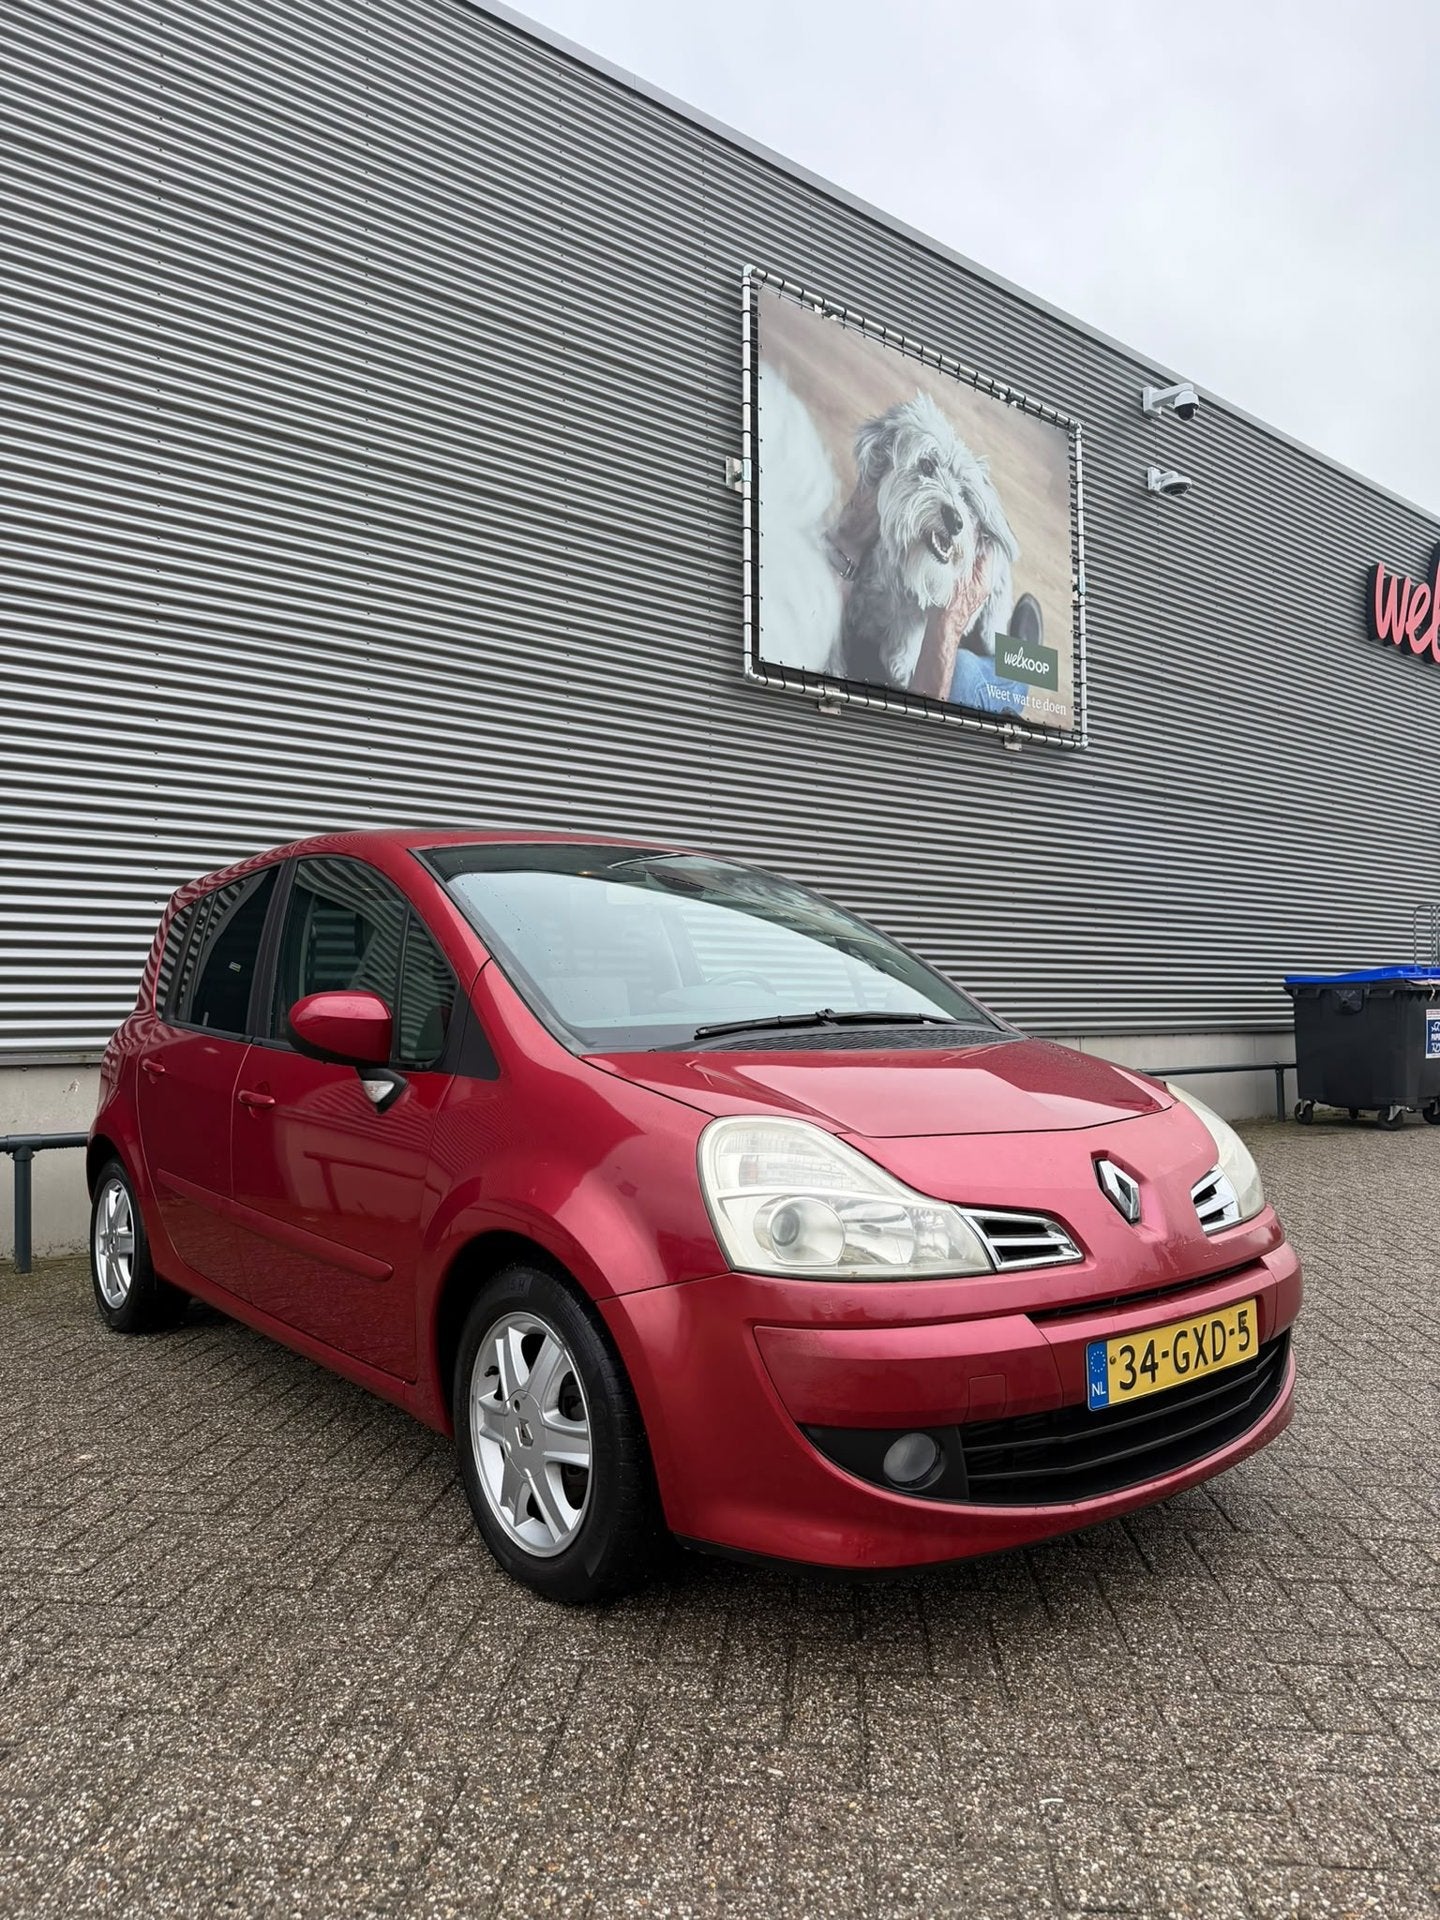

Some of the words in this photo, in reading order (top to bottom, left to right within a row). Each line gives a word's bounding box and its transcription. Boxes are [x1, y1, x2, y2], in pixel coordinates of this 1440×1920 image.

[986, 683, 1010, 702] Weet
[1013, 693, 1030, 707] wat
[1032, 697, 1042, 709] te
[1043, 698, 1067, 715] doen
[1119, 1309, 1251, 1391] 34-GXD-5
[1091, 1381, 1107, 1397] NL
